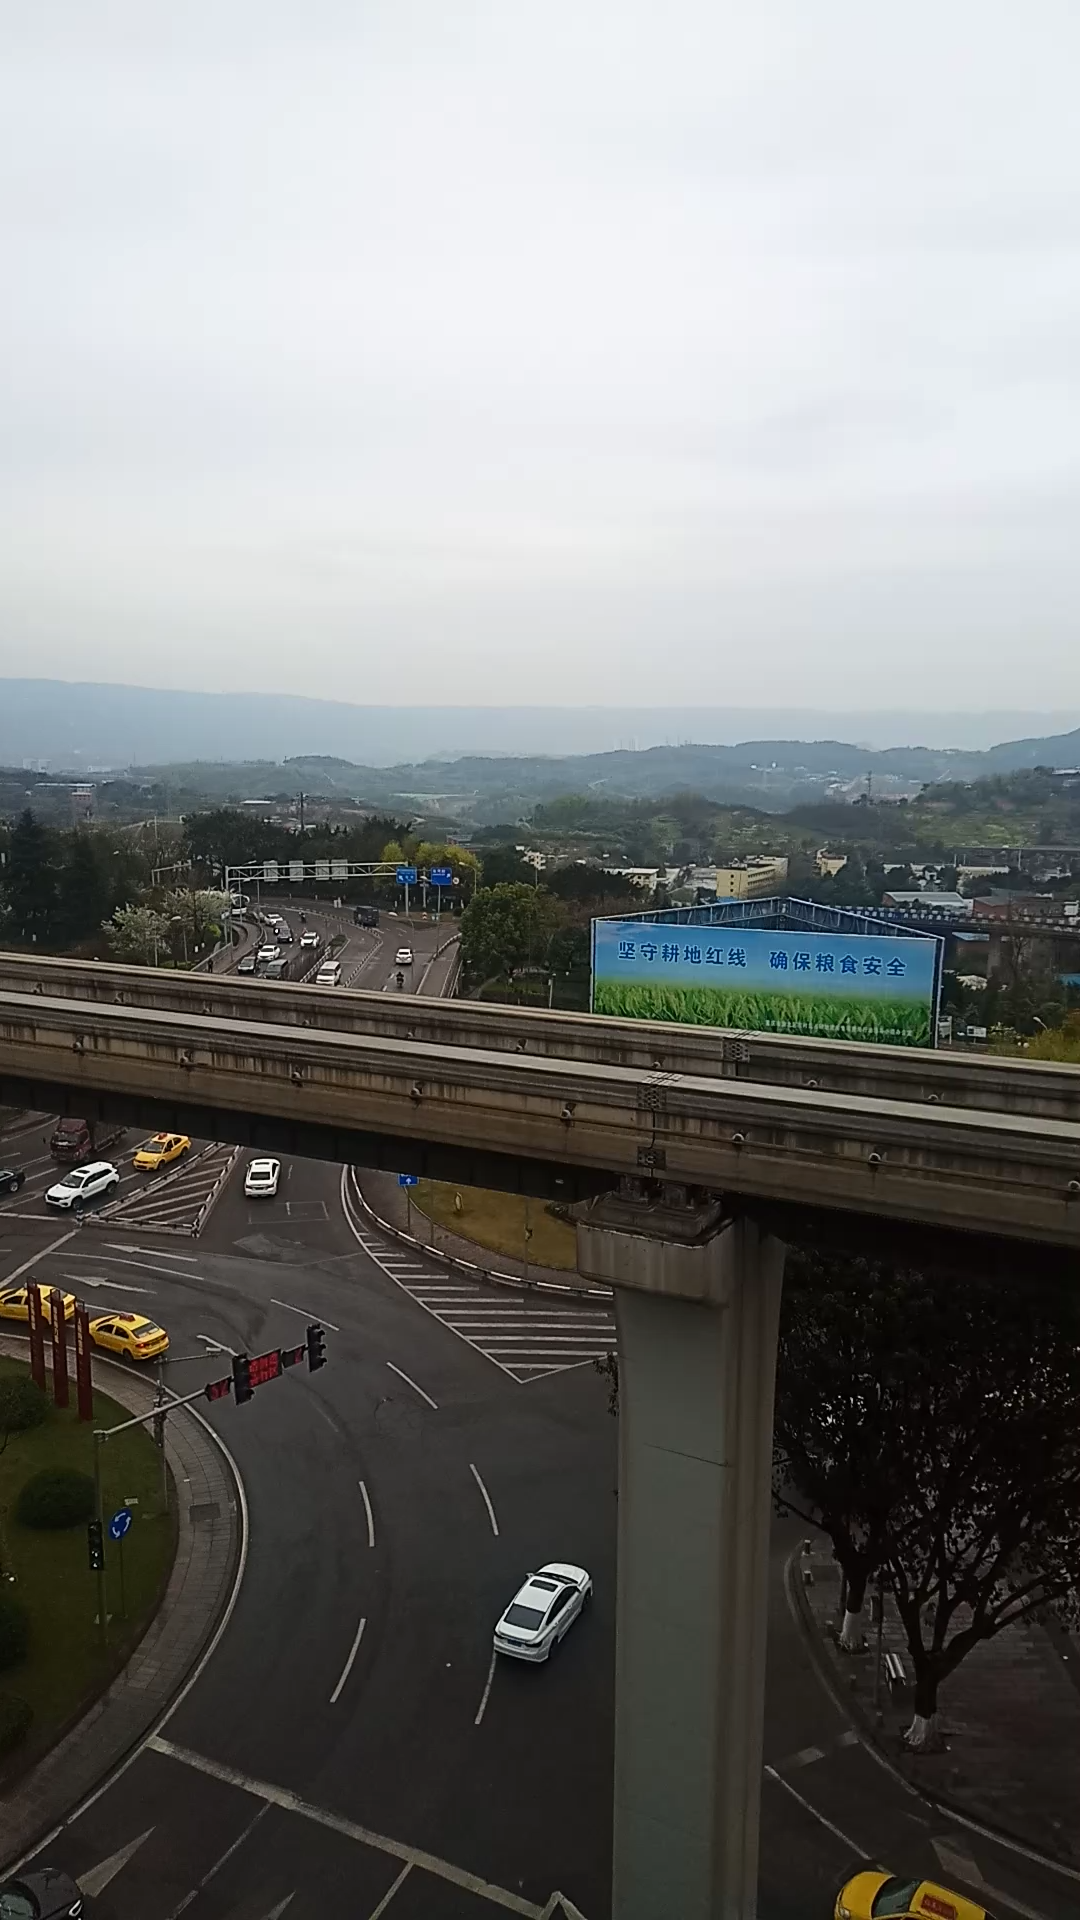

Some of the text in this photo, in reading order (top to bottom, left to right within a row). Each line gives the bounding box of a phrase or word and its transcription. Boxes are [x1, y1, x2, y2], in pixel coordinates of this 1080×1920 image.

[618, 941, 907, 977] 坚守耕地红线 确保粮食安全
